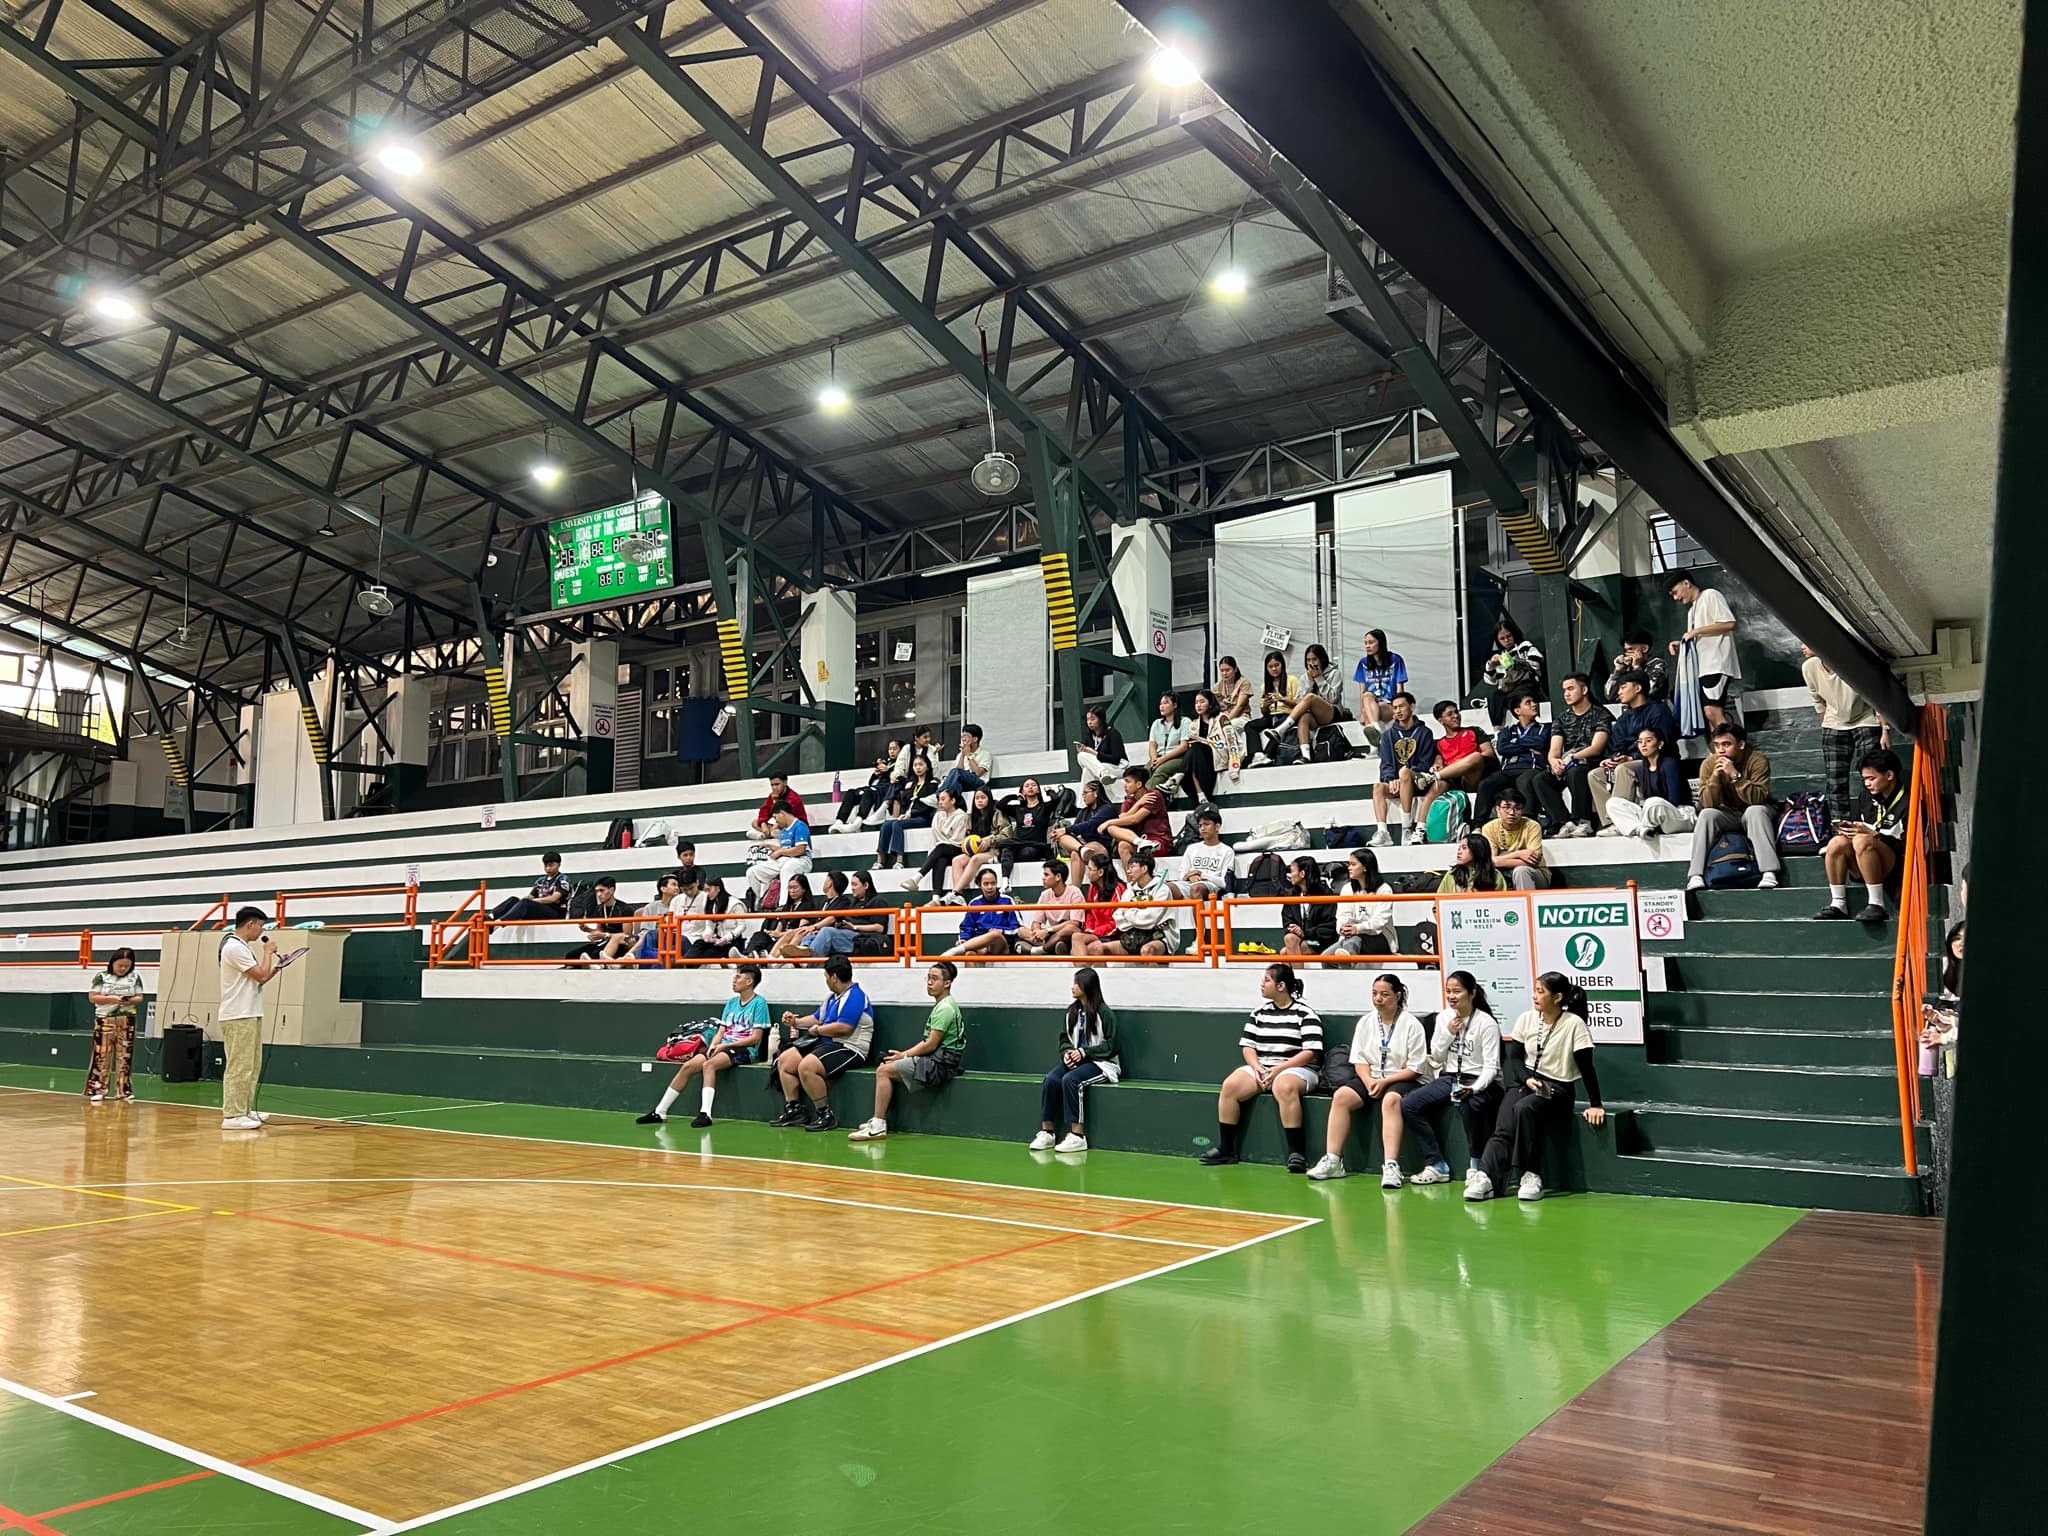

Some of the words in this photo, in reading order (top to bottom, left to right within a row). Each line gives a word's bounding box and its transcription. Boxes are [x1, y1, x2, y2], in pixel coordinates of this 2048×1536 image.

[560, 514, 593, 529] UNIVERSITY
[594, 512, 602, 521] OF
[640, 547, 667, 562] HOME
[554, 566, 579, 579] GUEST
[1476, 909, 1490, 917] UC
[1542, 906, 1625, 925] NOTICE
[1452, 949, 1457, 958] 1
[1489, 949, 1495, 957] 2
[1570, 976, 1614, 987] UBBER
